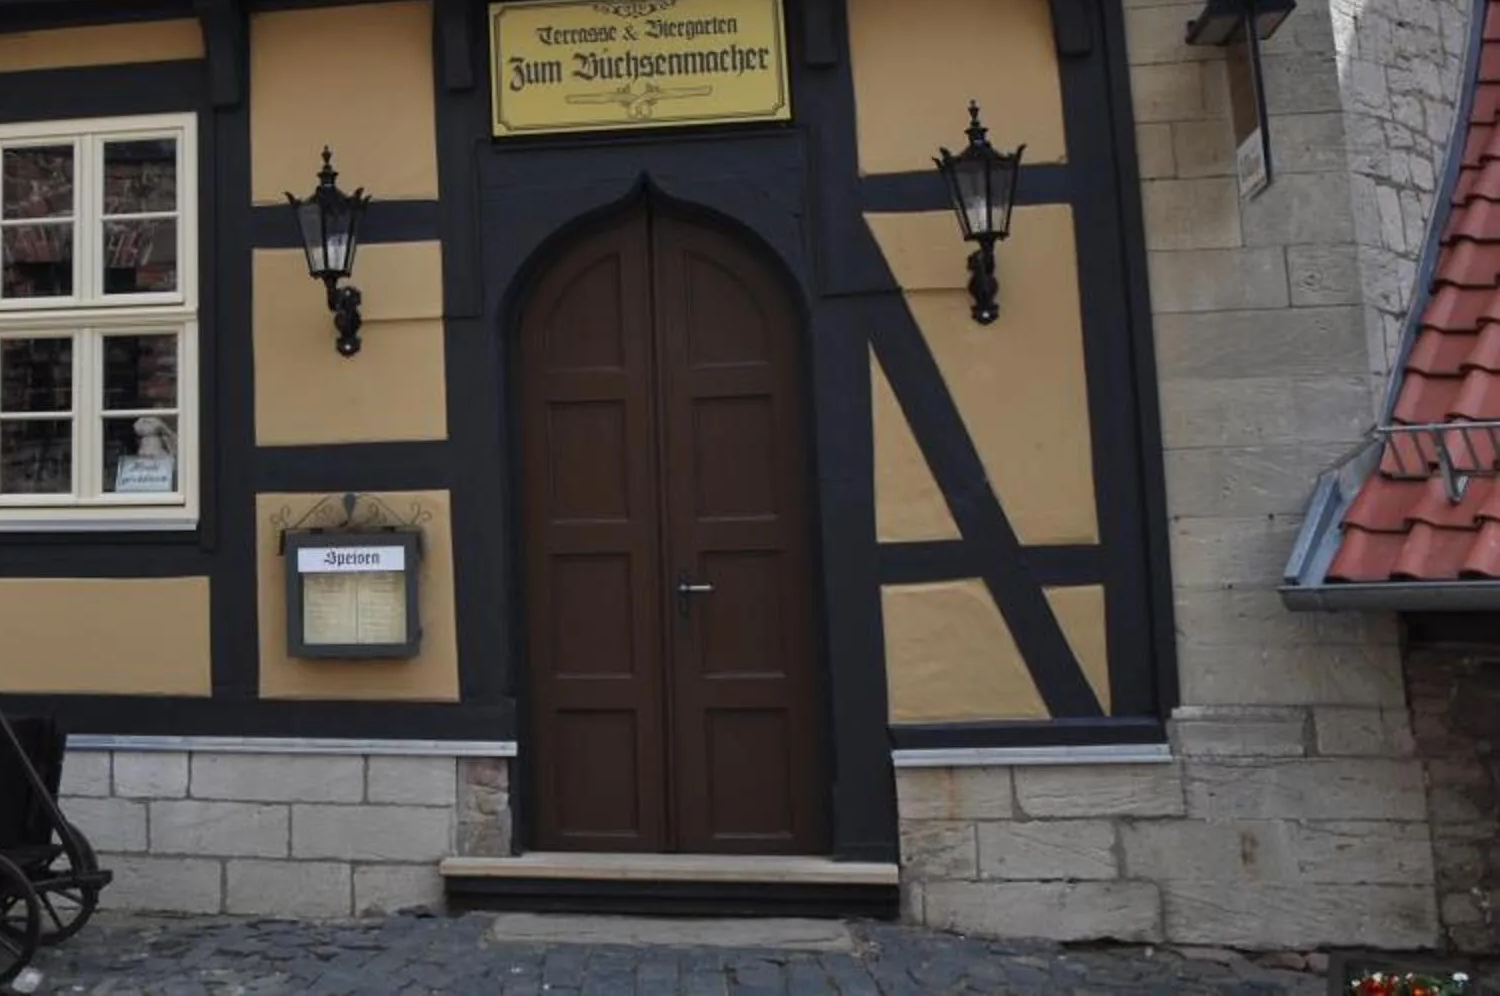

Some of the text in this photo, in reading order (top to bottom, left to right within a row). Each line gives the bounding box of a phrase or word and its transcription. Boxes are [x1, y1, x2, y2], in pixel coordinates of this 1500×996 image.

[536, 16, 738, 46] Terrasse & Biergarten
[508, 55, 563, 92] Zum
[323, 550, 381, 566] Speisen
